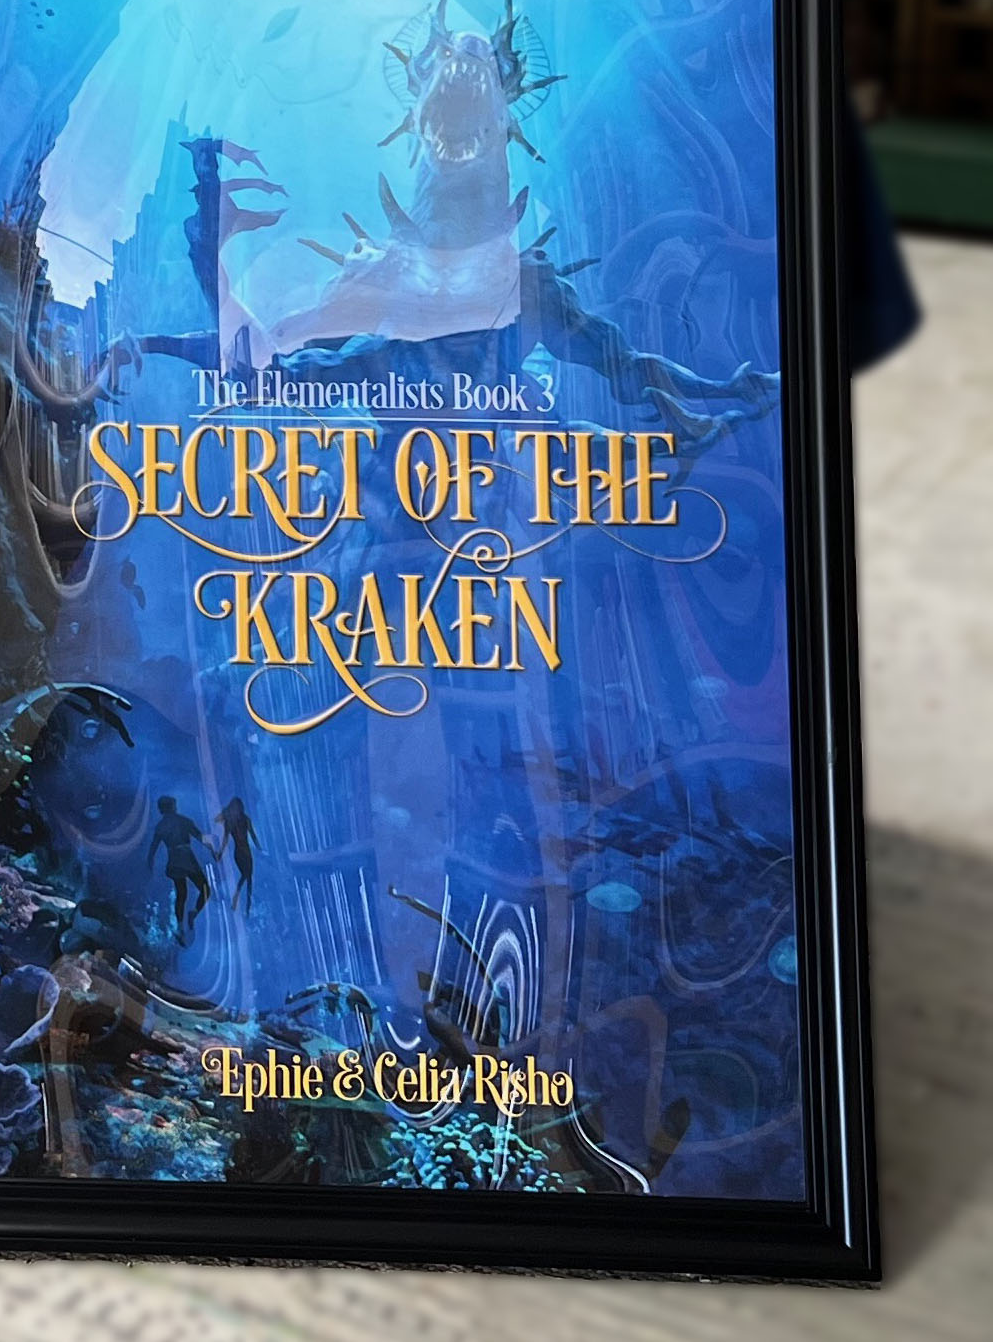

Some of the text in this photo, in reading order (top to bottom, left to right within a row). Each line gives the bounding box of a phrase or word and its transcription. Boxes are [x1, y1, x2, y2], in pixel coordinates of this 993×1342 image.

[192, 368, 556, 413] The Elementalists Book 3
[72, 421, 684, 556] SECRET OF THE
[194, 566, 562, 720] KRAKEN
[201, 1046, 574, 1118] Ephie & Celia Risho
